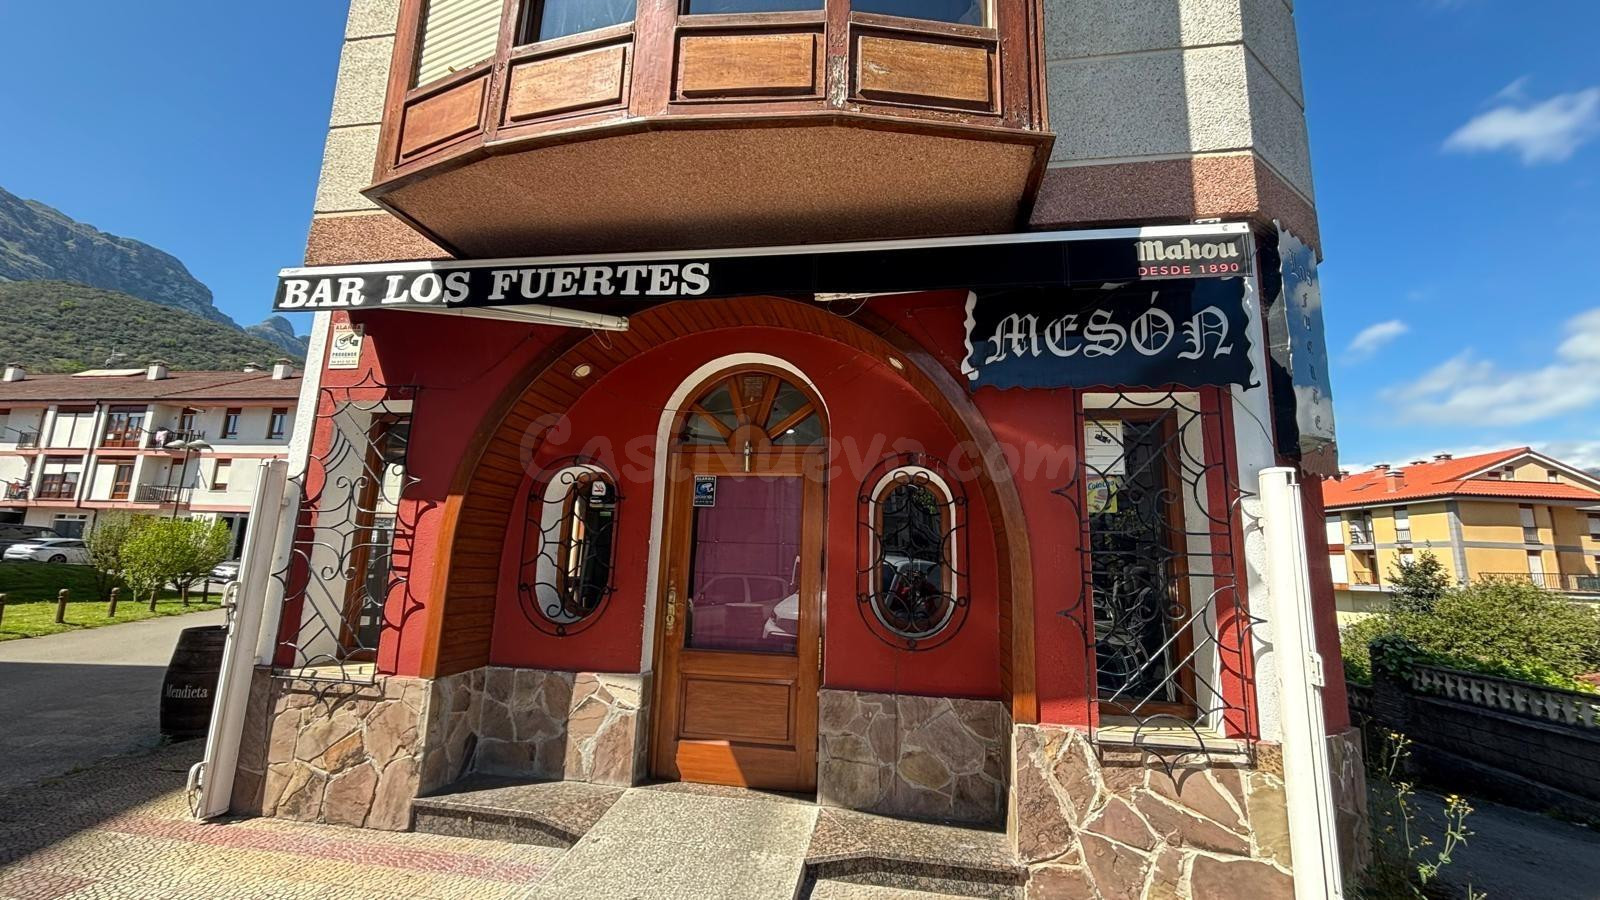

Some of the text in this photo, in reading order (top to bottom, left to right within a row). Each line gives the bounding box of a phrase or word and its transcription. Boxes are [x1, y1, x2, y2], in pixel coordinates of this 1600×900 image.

[1134, 238, 1239, 260] Mahou
[278, 262, 710, 308] BAR LOS FUERTES
[1138, 263, 1239, 275] DESDE 1890
[985, 290, 1234, 364] MESÓN
